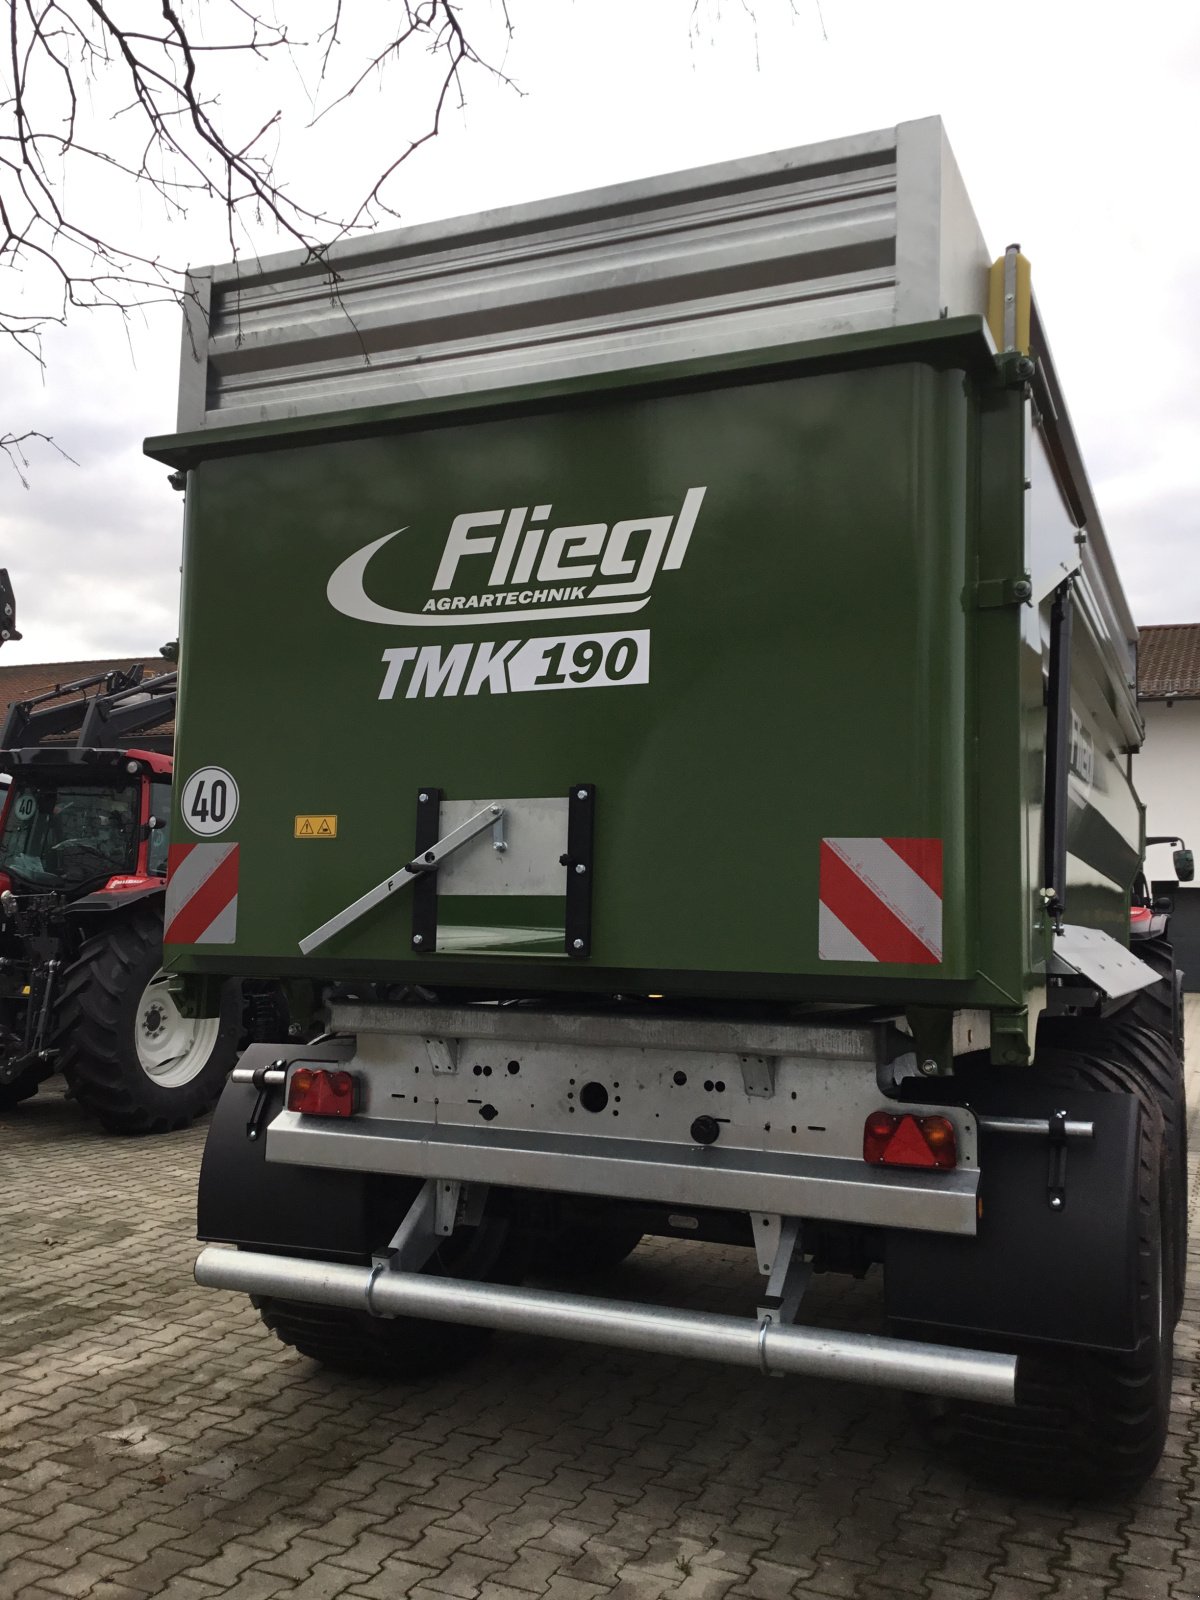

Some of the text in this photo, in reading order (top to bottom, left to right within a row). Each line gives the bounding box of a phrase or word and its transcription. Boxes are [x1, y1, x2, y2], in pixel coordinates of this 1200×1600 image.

[432, 486, 708, 599] Fliegl
[422, 585, 588, 612] AGRARTECHNIK
[378, 637, 639, 700] TMK 190
[190, 779, 227, 823] 40
